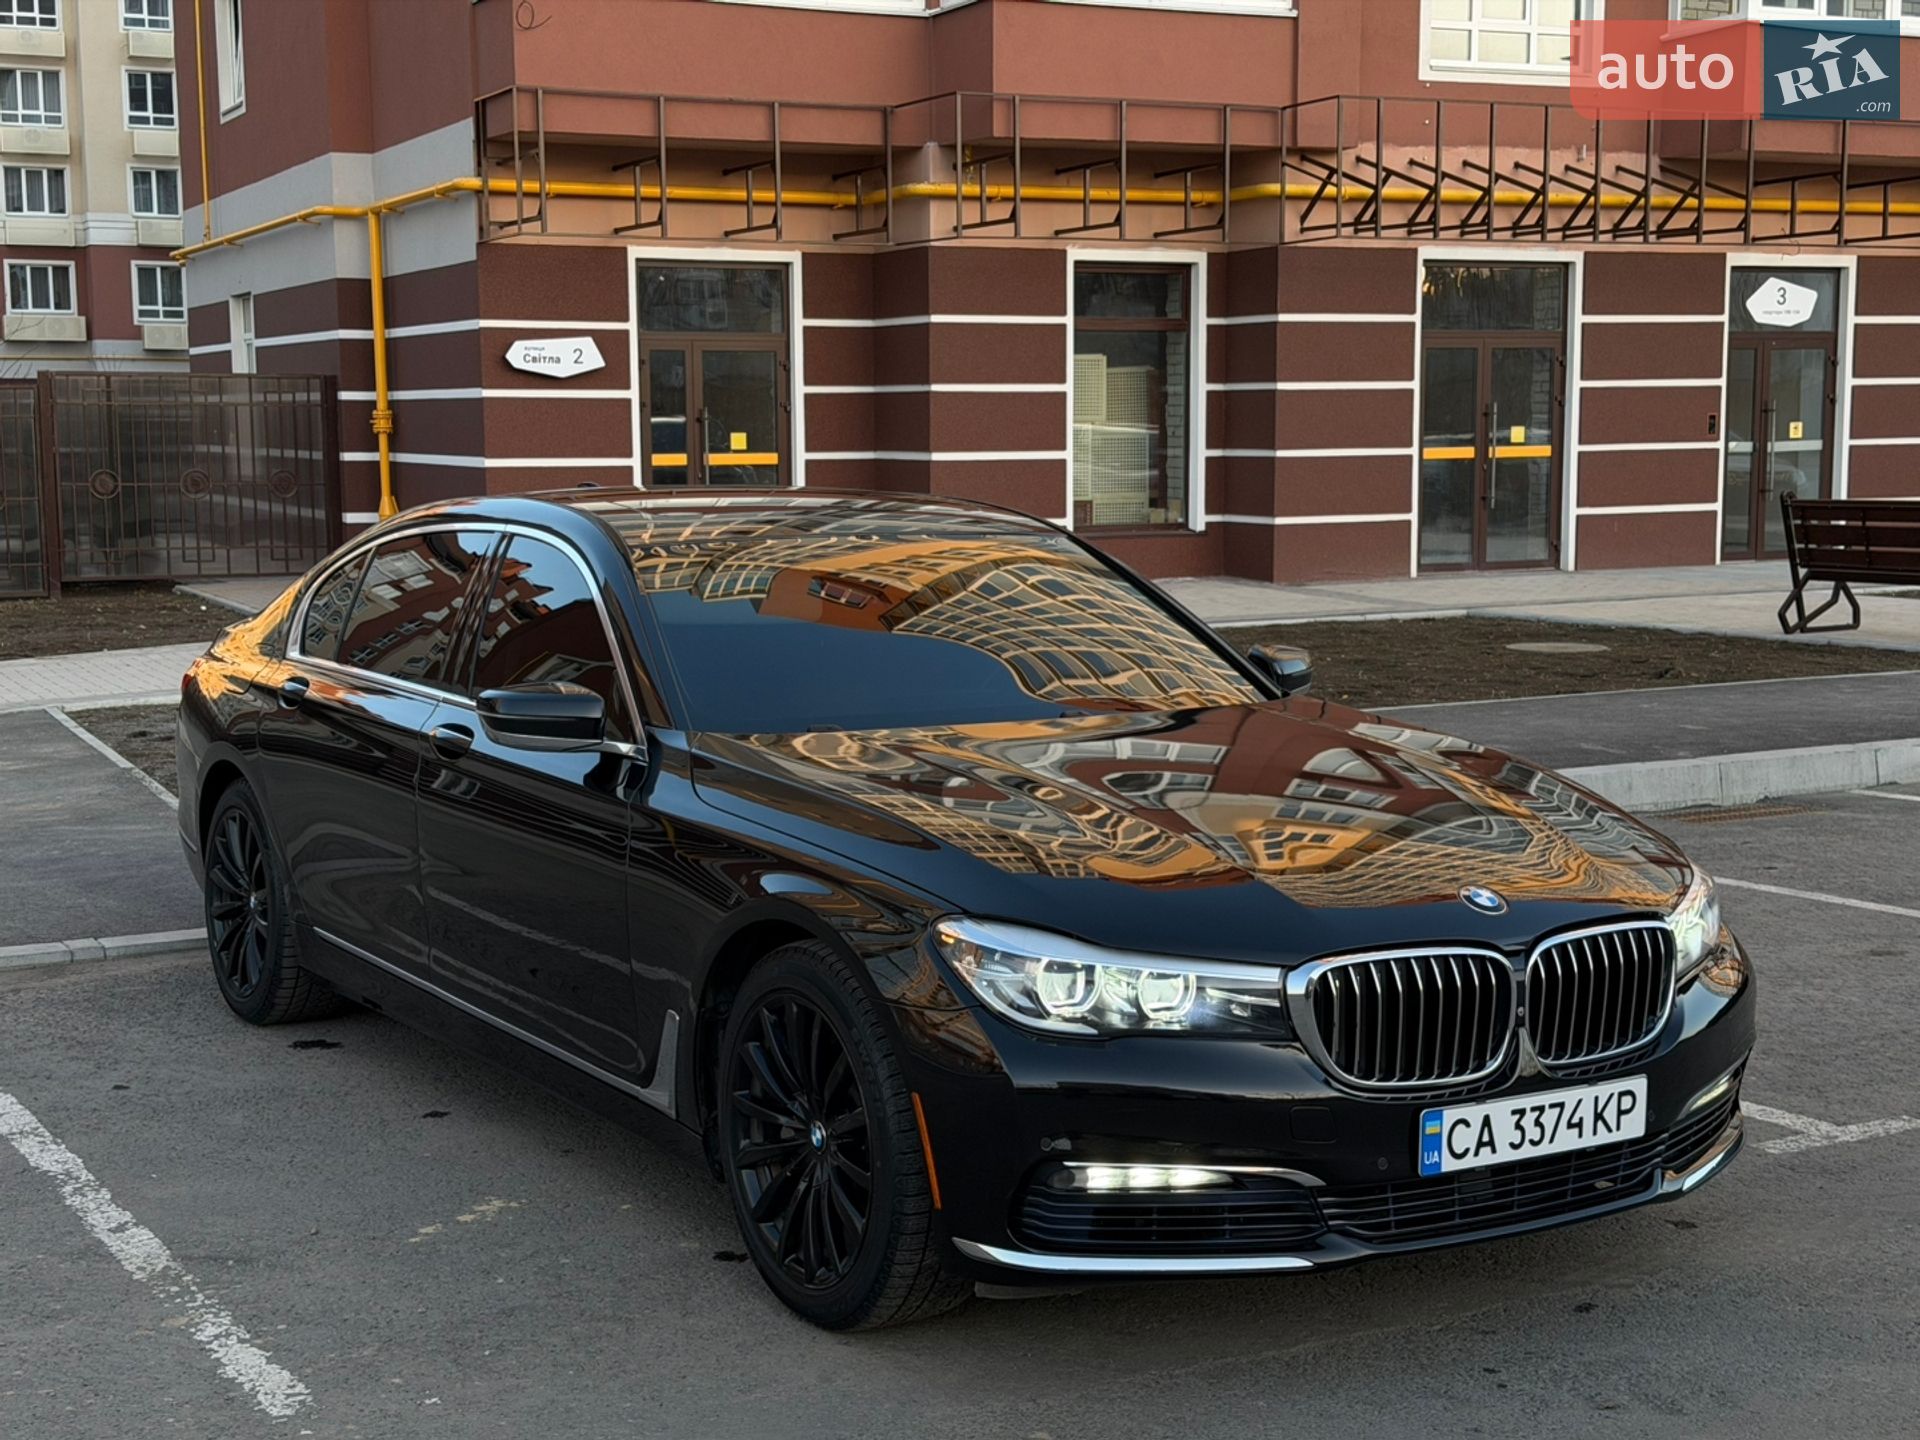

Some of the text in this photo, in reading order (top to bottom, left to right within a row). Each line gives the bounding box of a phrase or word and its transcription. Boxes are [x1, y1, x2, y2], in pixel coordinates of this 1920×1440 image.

[1776, 286, 1787, 306] 3
[522, 347, 584, 365] Світла 2
[1508, 1098, 1584, 1151] 3374
[1424, 1151, 1440, 1165] UA
